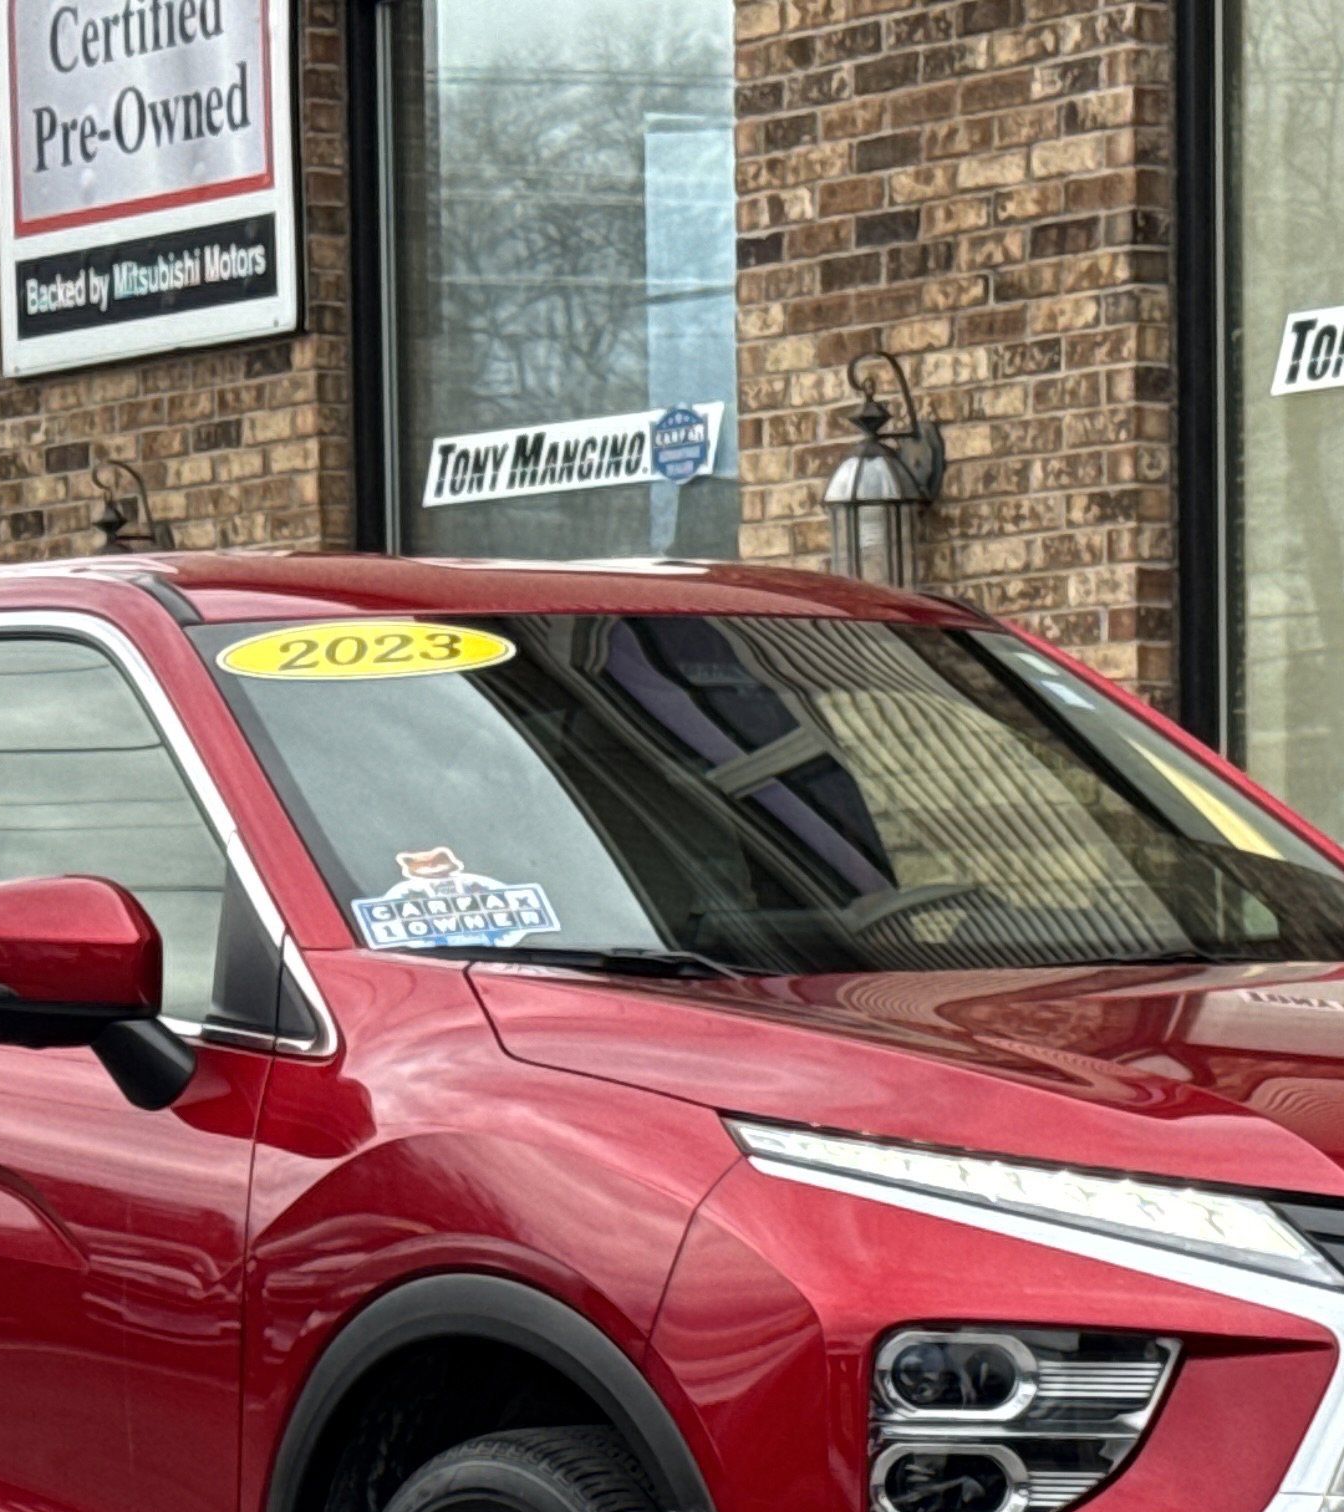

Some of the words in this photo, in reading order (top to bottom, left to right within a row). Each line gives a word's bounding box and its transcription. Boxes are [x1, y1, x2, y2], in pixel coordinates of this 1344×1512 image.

[49, 0, 225, 74] Certified
[33, 61, 251, 173] Pre-Owned
[25, 269, 86, 316] Backed
[88, 266, 110, 312] by
[112, 248, 201, 300] Mitsubishi
[203, 243, 266, 283] Motors
[433, 443, 509, 499] TONY
[278, 632, 463, 671] 2023
[369, 892, 540, 922] CARFAX
[407, 909, 543, 937] OWNER
